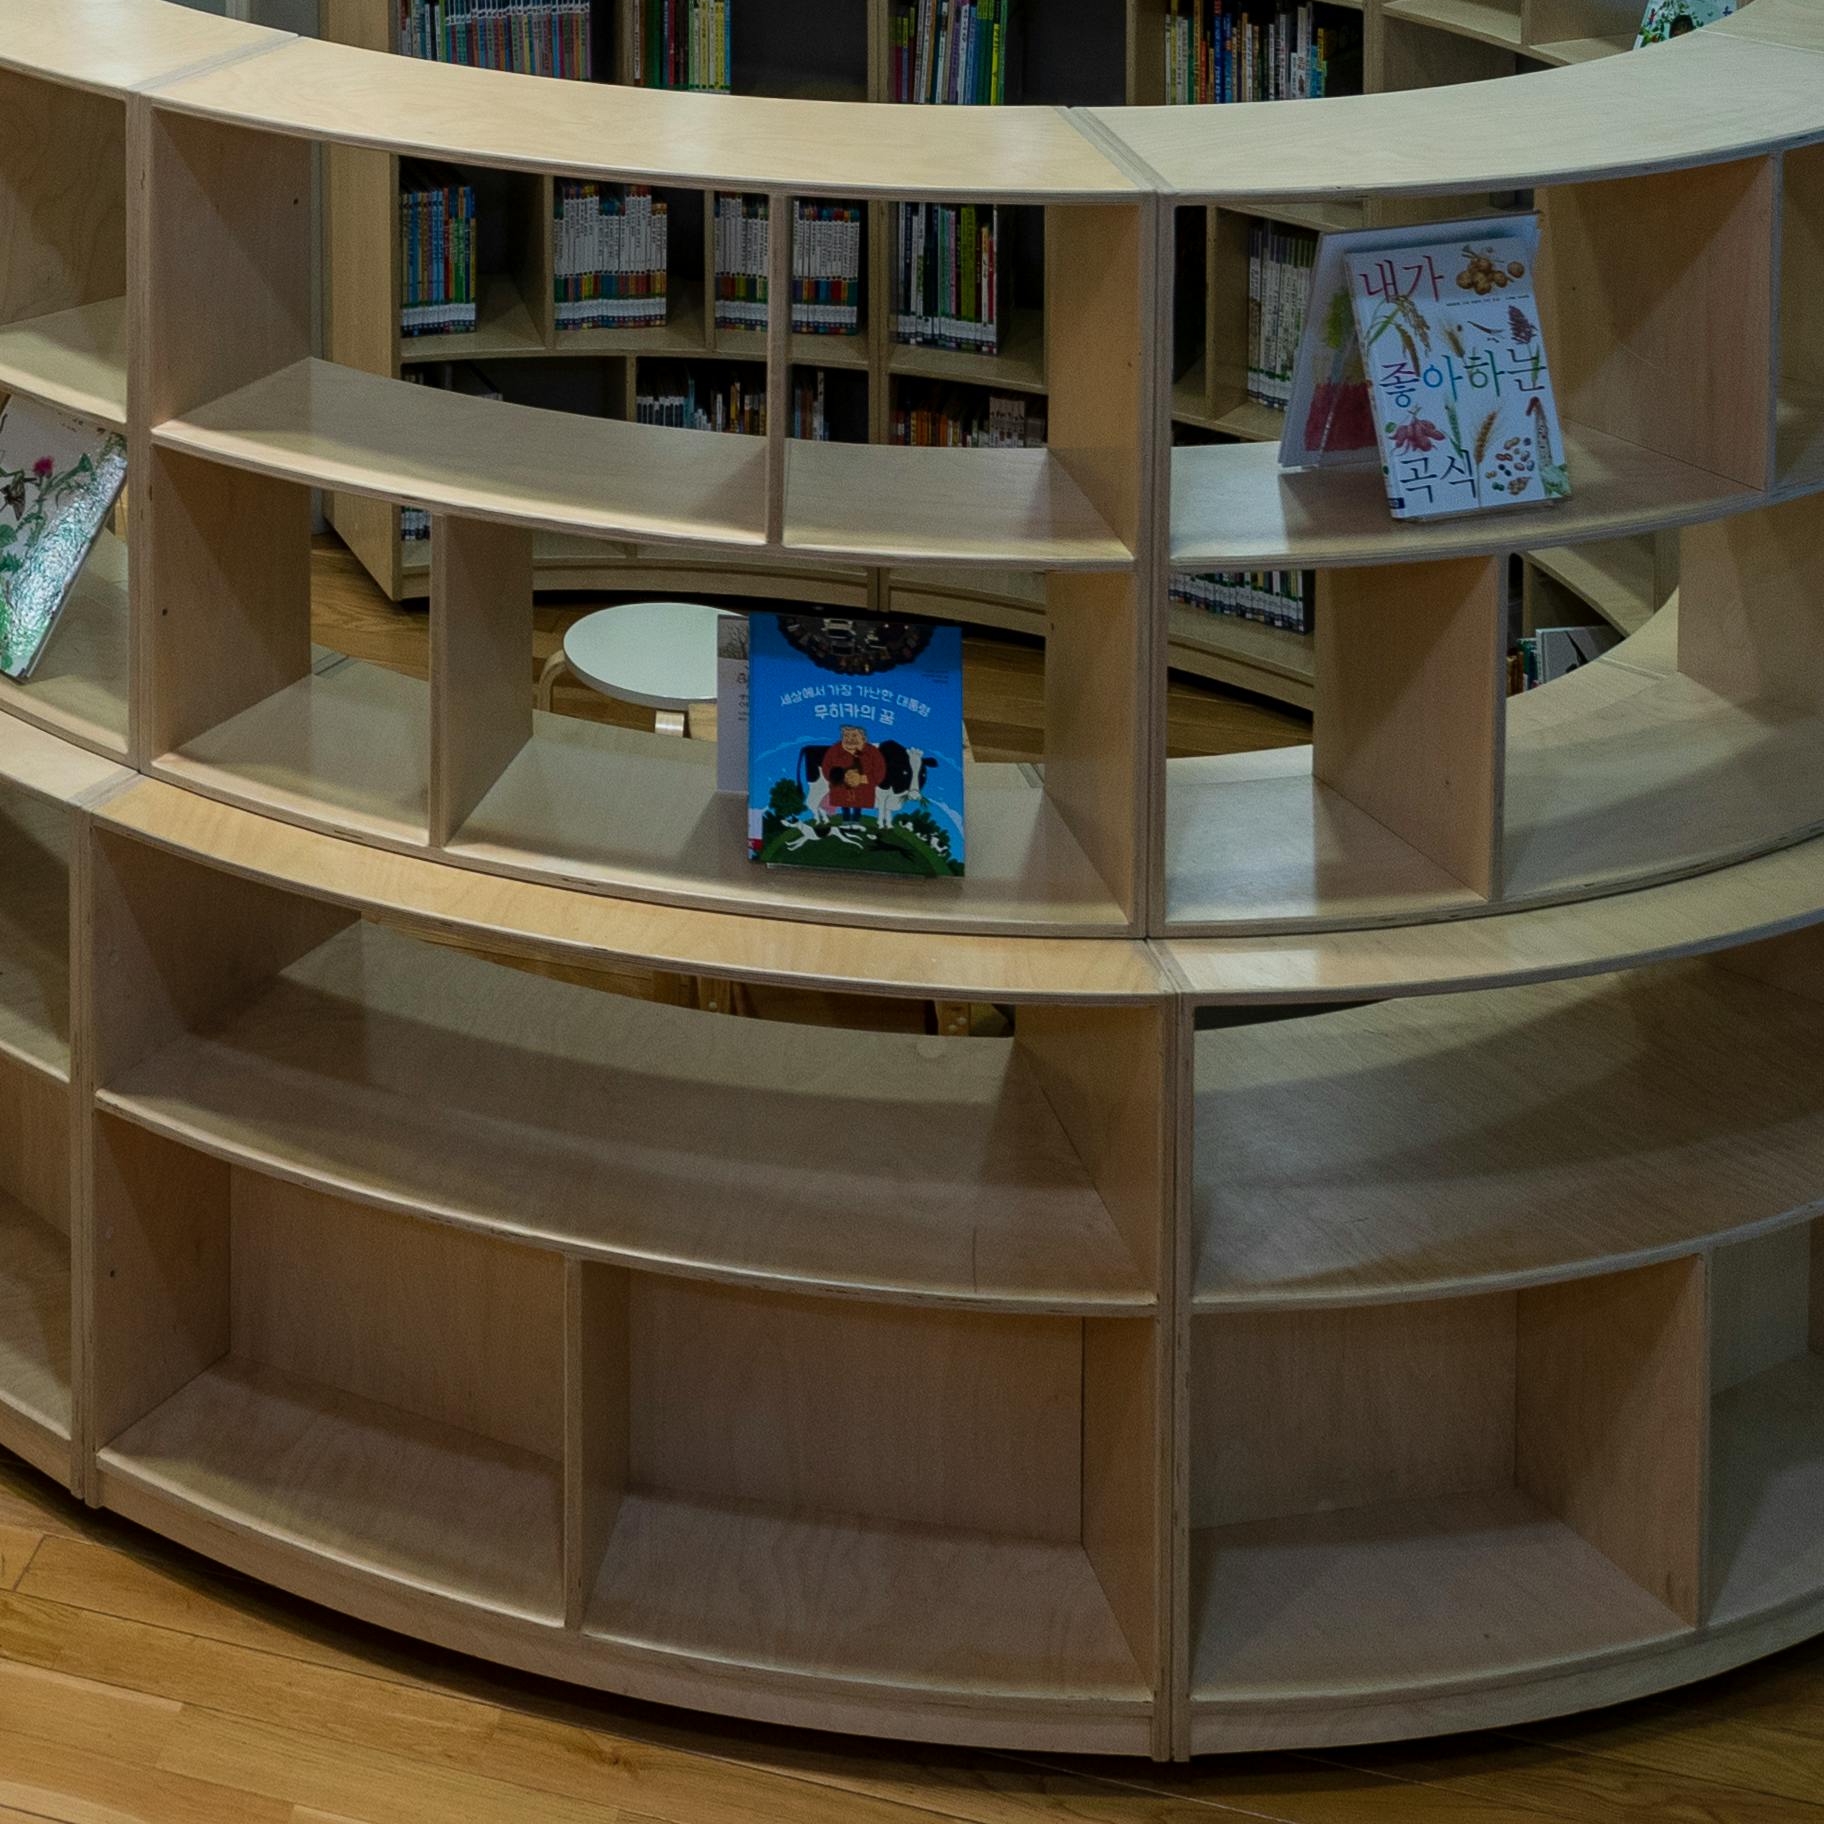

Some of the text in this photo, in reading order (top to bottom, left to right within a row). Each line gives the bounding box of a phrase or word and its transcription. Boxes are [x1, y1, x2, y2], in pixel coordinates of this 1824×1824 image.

[1359, 255, 1445, 303] 내가
[1379, 349, 1547, 408] 좋아하는
[1400, 449, 1478, 504] 곡식
[780, 684, 932, 717] 세상에서 가장 가난한 대통령
[814, 702, 896, 726] 무히카의 꿈
